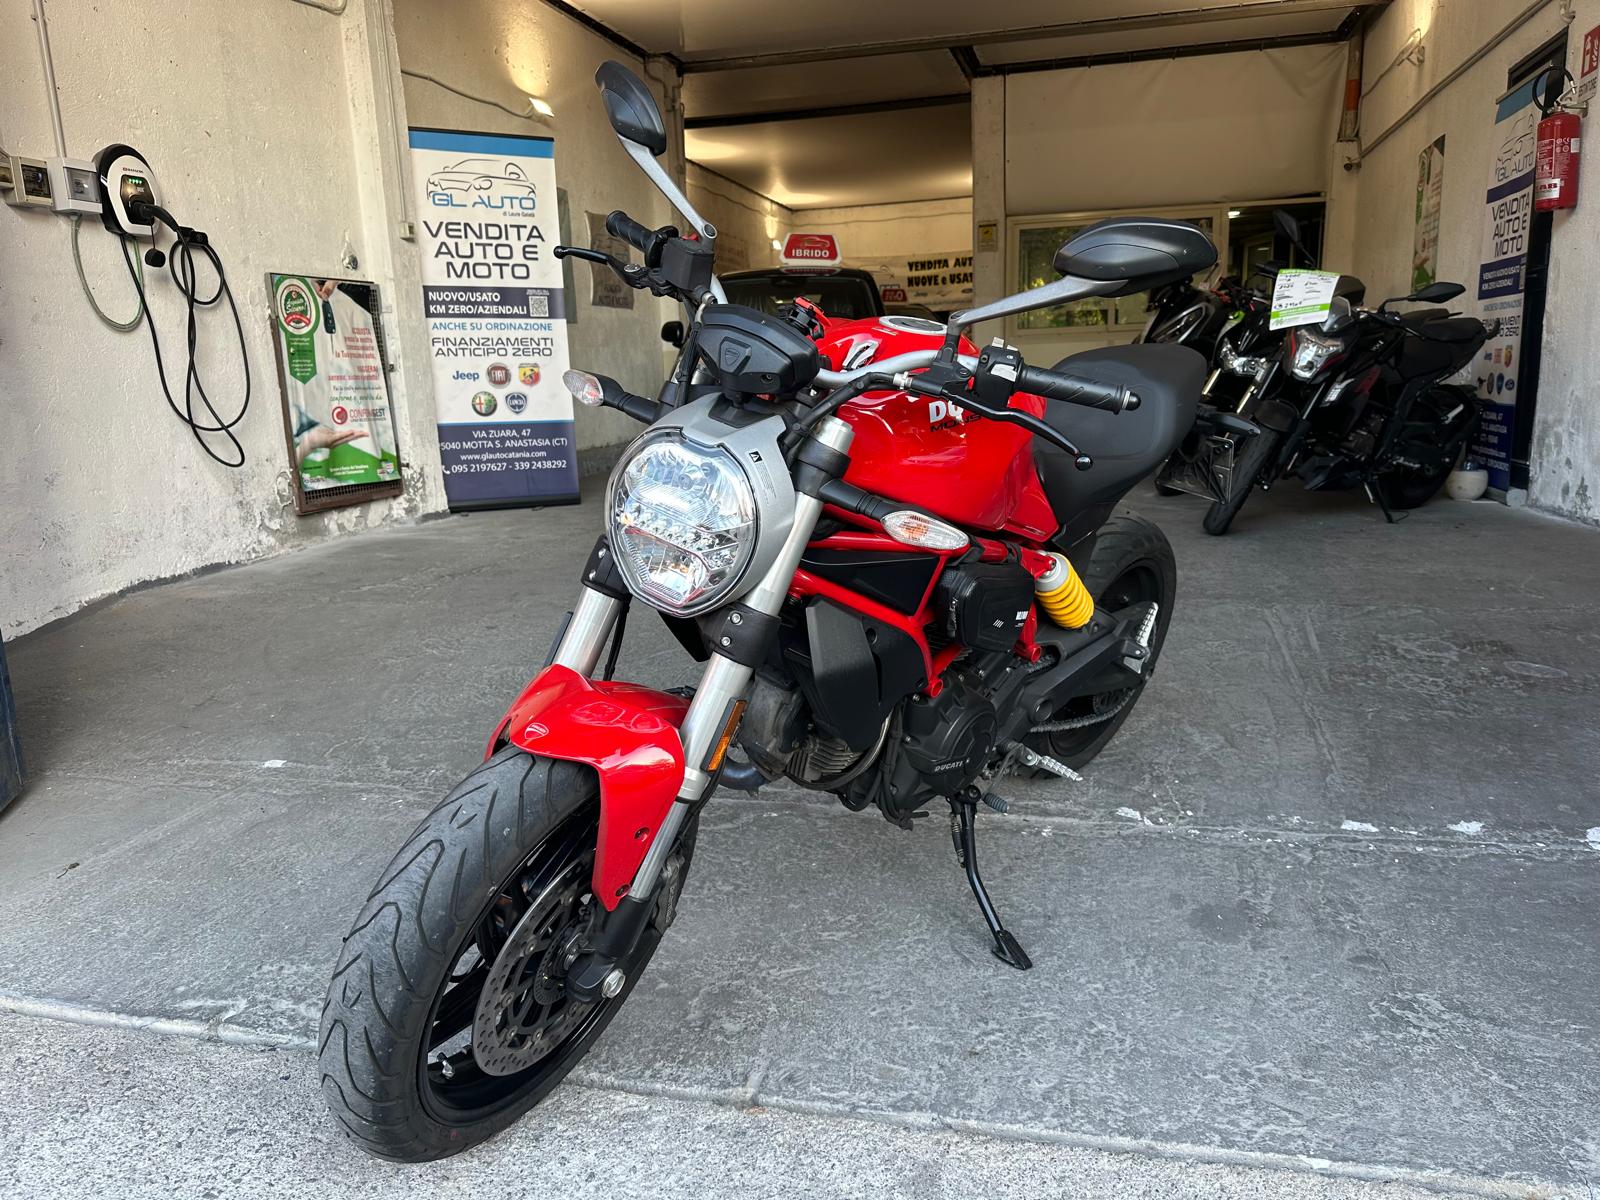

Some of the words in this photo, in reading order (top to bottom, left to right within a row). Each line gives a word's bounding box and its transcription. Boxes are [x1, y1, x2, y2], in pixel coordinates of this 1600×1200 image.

[432, 193, 467, 208] GL
[472, 194, 536, 210] AUTO
[1491, 191, 1530, 222] VENDITA
[423, 220, 545, 242] VENDITA
[1493, 215, 1520, 241] AUTO
[1521, 213, 1528, 230] E
[434, 242, 513, 260] AUTO
[522, 244, 539, 261] E
[792, 248, 830, 258] IBRIDO
[1494, 234, 1523, 259] MOTO
[446, 261, 531, 280] MOTO
[907, 258, 949, 273] VENDITA
[907, 274, 939, 288] NUOVE
[941, 276, 947, 285] e
[428, 291, 501, 302] NUOVO/USATO
[429, 304, 446, 314] KM
[448, 305, 527, 315] ZERO/AZIENDALI
[432, 322, 467, 331] ANCHE
[470, 322, 482, 331] SU
[485, 322, 553, 331] ORDINAZIONE
[431, 337, 554, 347] FINANZIAMENTI
[435, 347, 508, 357] ANTICIPO
[512, 347, 553, 357] ZERO
[452, 371, 480, 382] Jeep
[490, 369, 506, 382] FIAT
[472, 430, 487, 438] VIA
[489, 430, 520, 439] ZUARA,
[521, 429, 531, 437] 47
[462, 440, 494, 449] MOTTA
[495, 440, 503, 448] S.
[504, 438, 551, 448] ANASTASIA
[552, 438, 568, 447] (CT)
[460, 450, 547, 461] www.glautocatania.com
[451, 464, 468, 474] 095
[470, 462, 507, 473] 2197627
[514, 461, 530, 471] 339
[531, 460, 567, 470] 2438292
[934, 760, 963, 772] DUCATI
